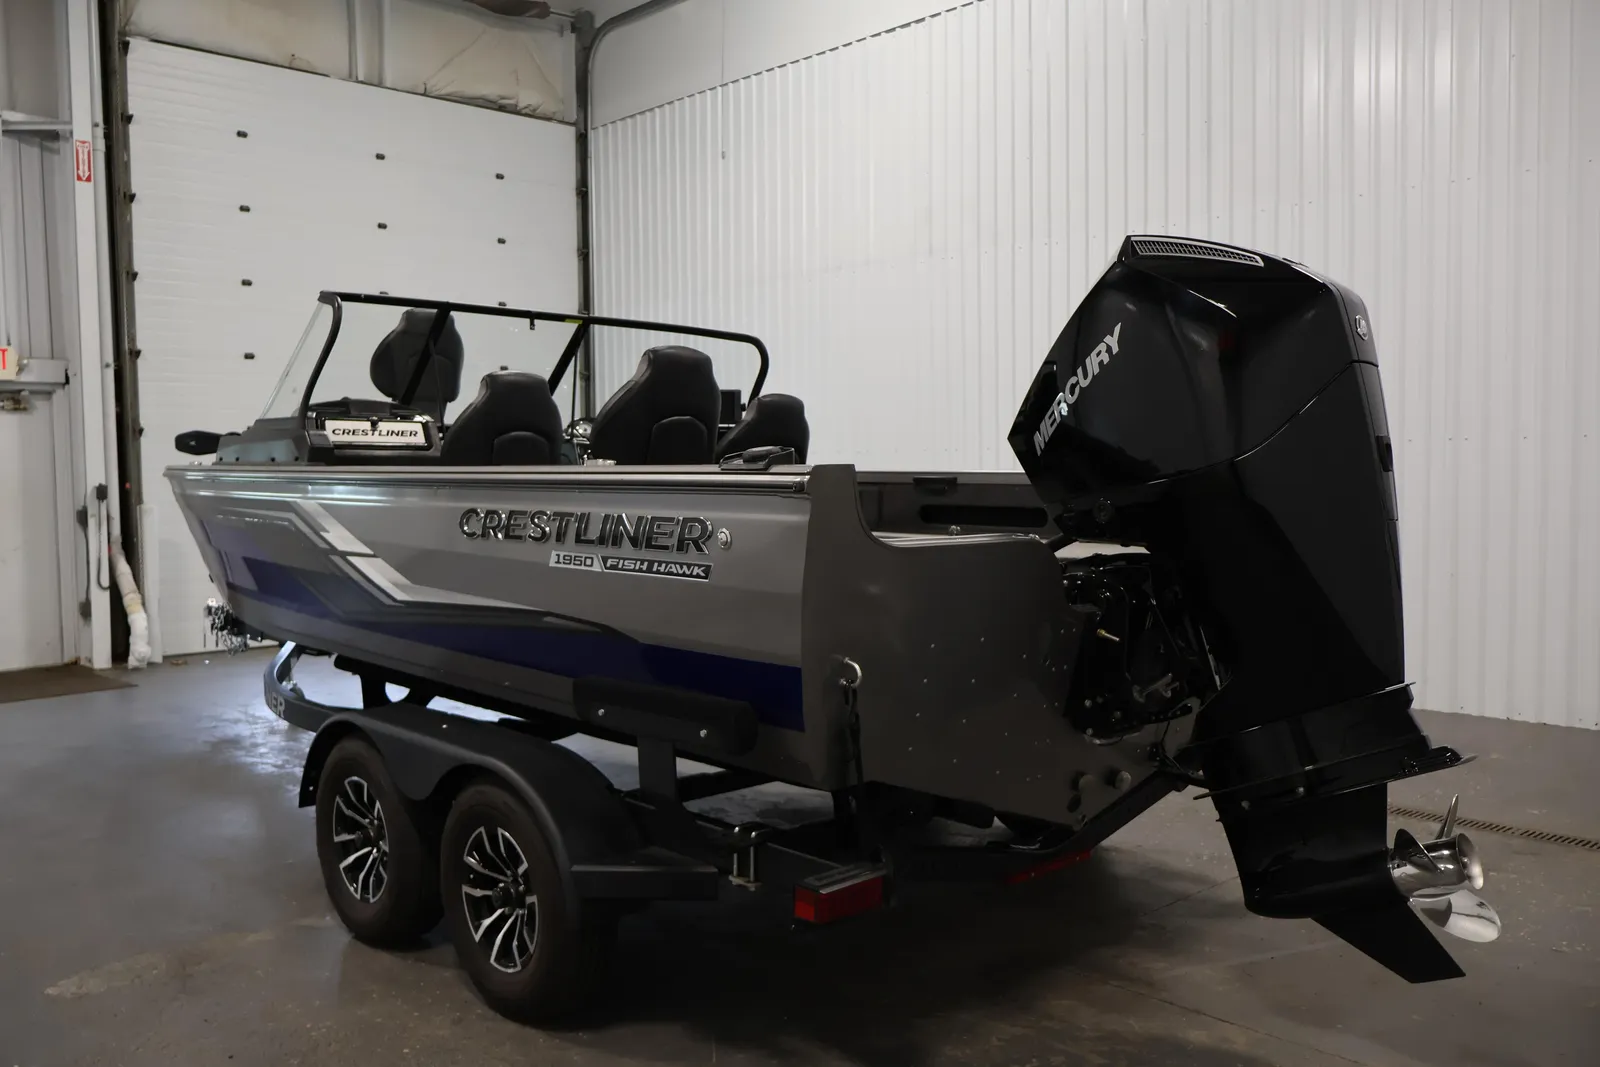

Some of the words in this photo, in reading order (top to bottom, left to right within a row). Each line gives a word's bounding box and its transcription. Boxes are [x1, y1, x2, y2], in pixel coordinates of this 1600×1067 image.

[1033, 322, 1122, 457] MERCURY
[332, 428, 418, 437] CRESTLINER
[459, 508, 712, 555] CRESTLINER
[554, 553, 594, 567] 1950
[606, 558, 648, 571] FISH
[652, 562, 706, 577] HAWK
